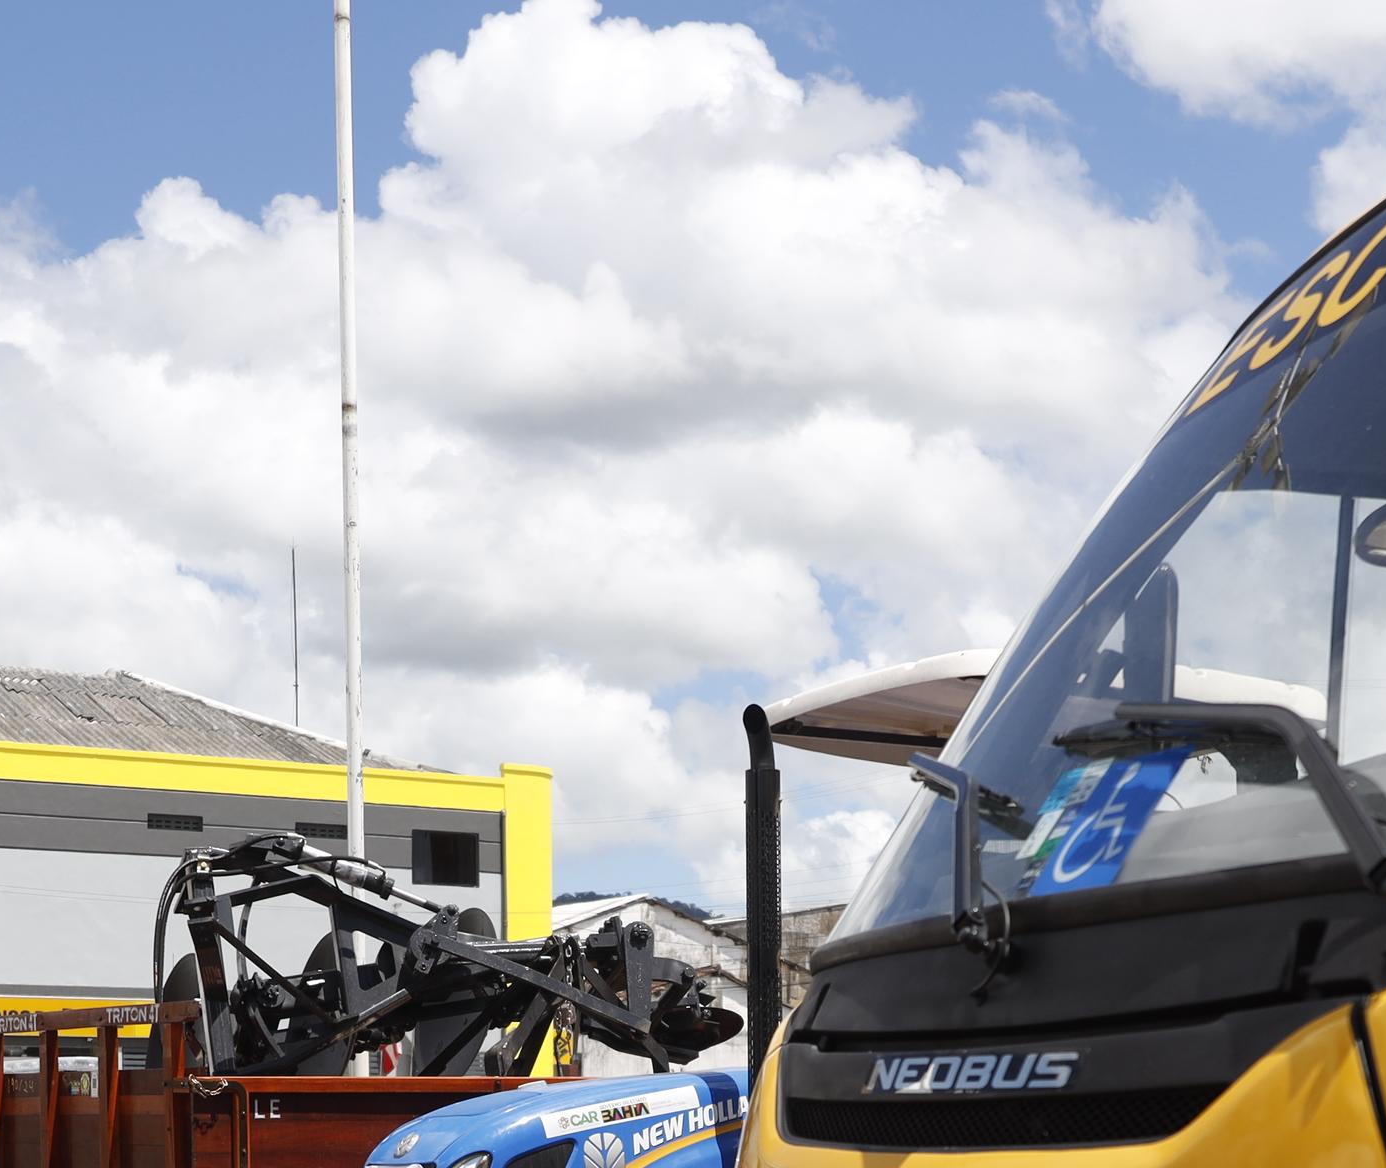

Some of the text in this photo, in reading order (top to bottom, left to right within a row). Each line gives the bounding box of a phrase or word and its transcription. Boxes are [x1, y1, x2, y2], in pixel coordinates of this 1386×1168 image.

[106, 1007, 147, 1024] TRITON
[865, 1051, 1079, 1090] NEOBUS
[570, 1110, 598, 1126] CAR
[601, 1103, 649, 1123] BAHIA
[633, 1114, 684, 1155] NEW
